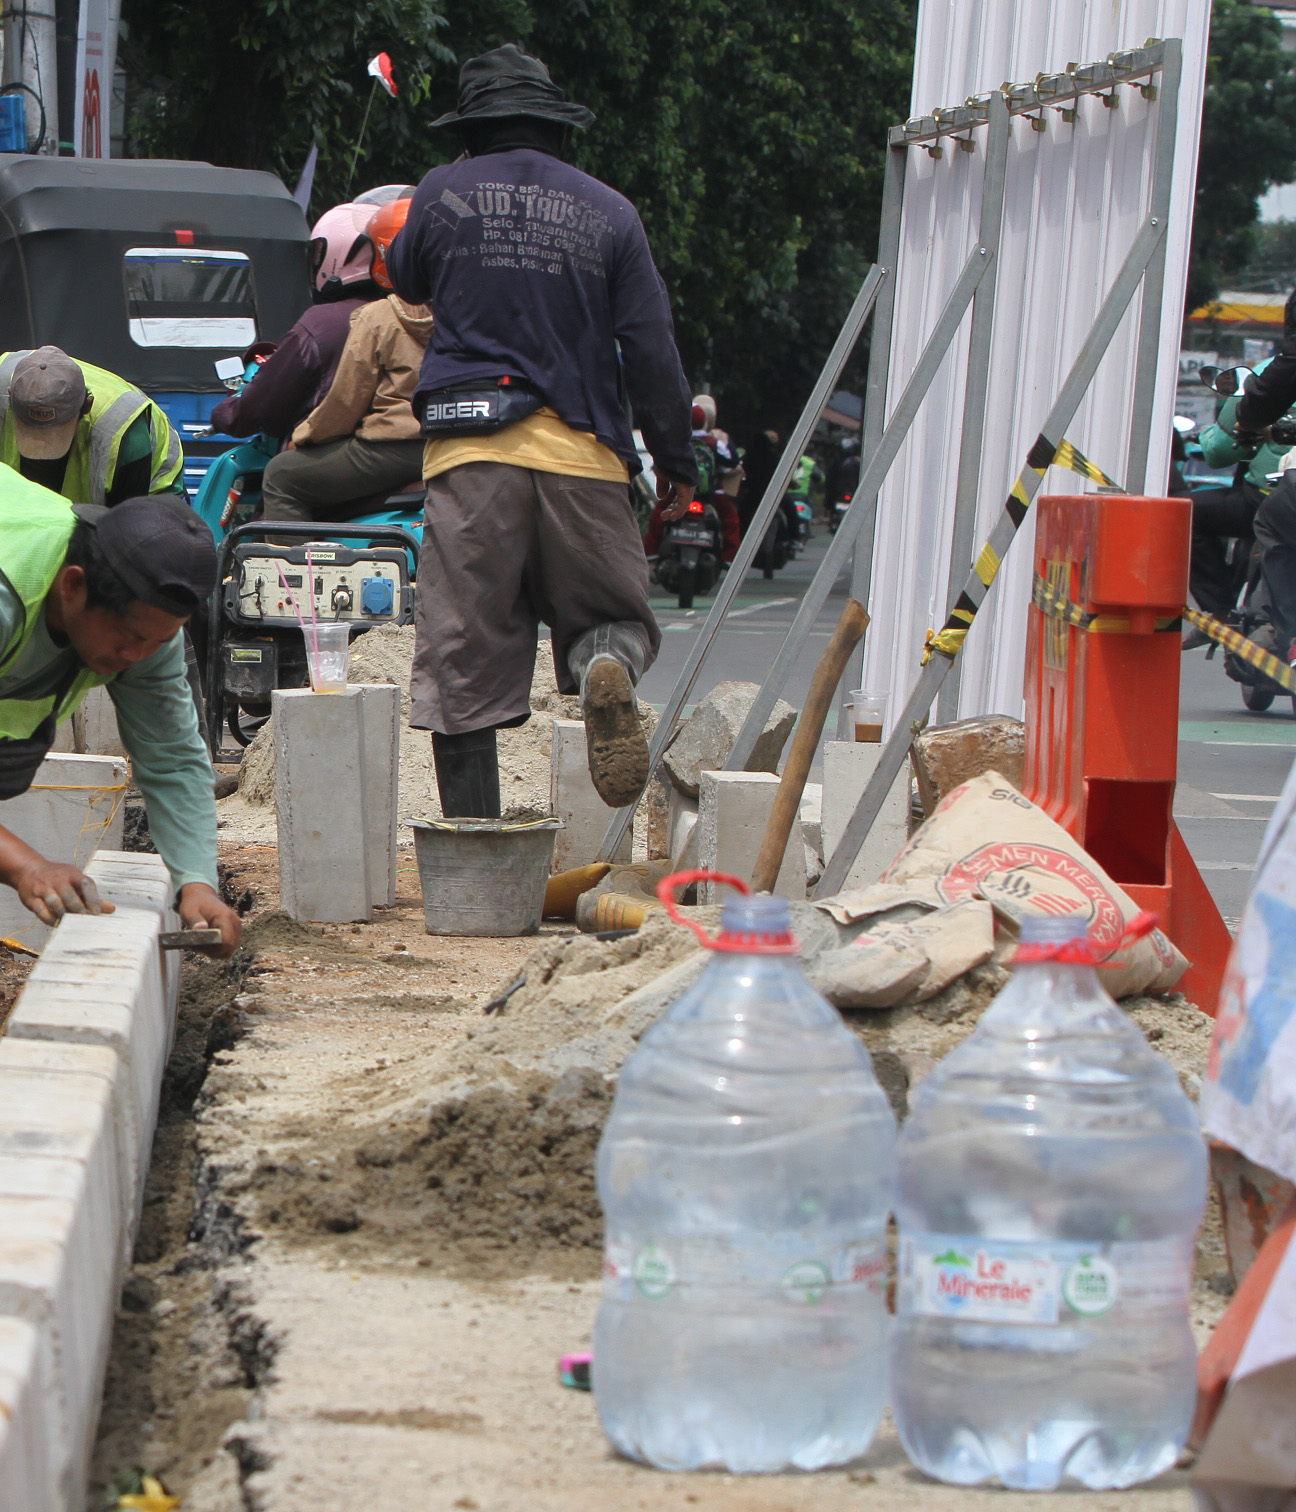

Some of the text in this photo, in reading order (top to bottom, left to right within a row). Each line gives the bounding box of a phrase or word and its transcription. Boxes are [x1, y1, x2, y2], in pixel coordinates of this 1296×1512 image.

[476, 182, 515, 192] TOKO
[482, 217, 514, 229] Selo
[962, 846, 1049, 875] SEMEN
[977, 1253, 1006, 1280] Le
[937, 1271, 1033, 1303] Minerale
